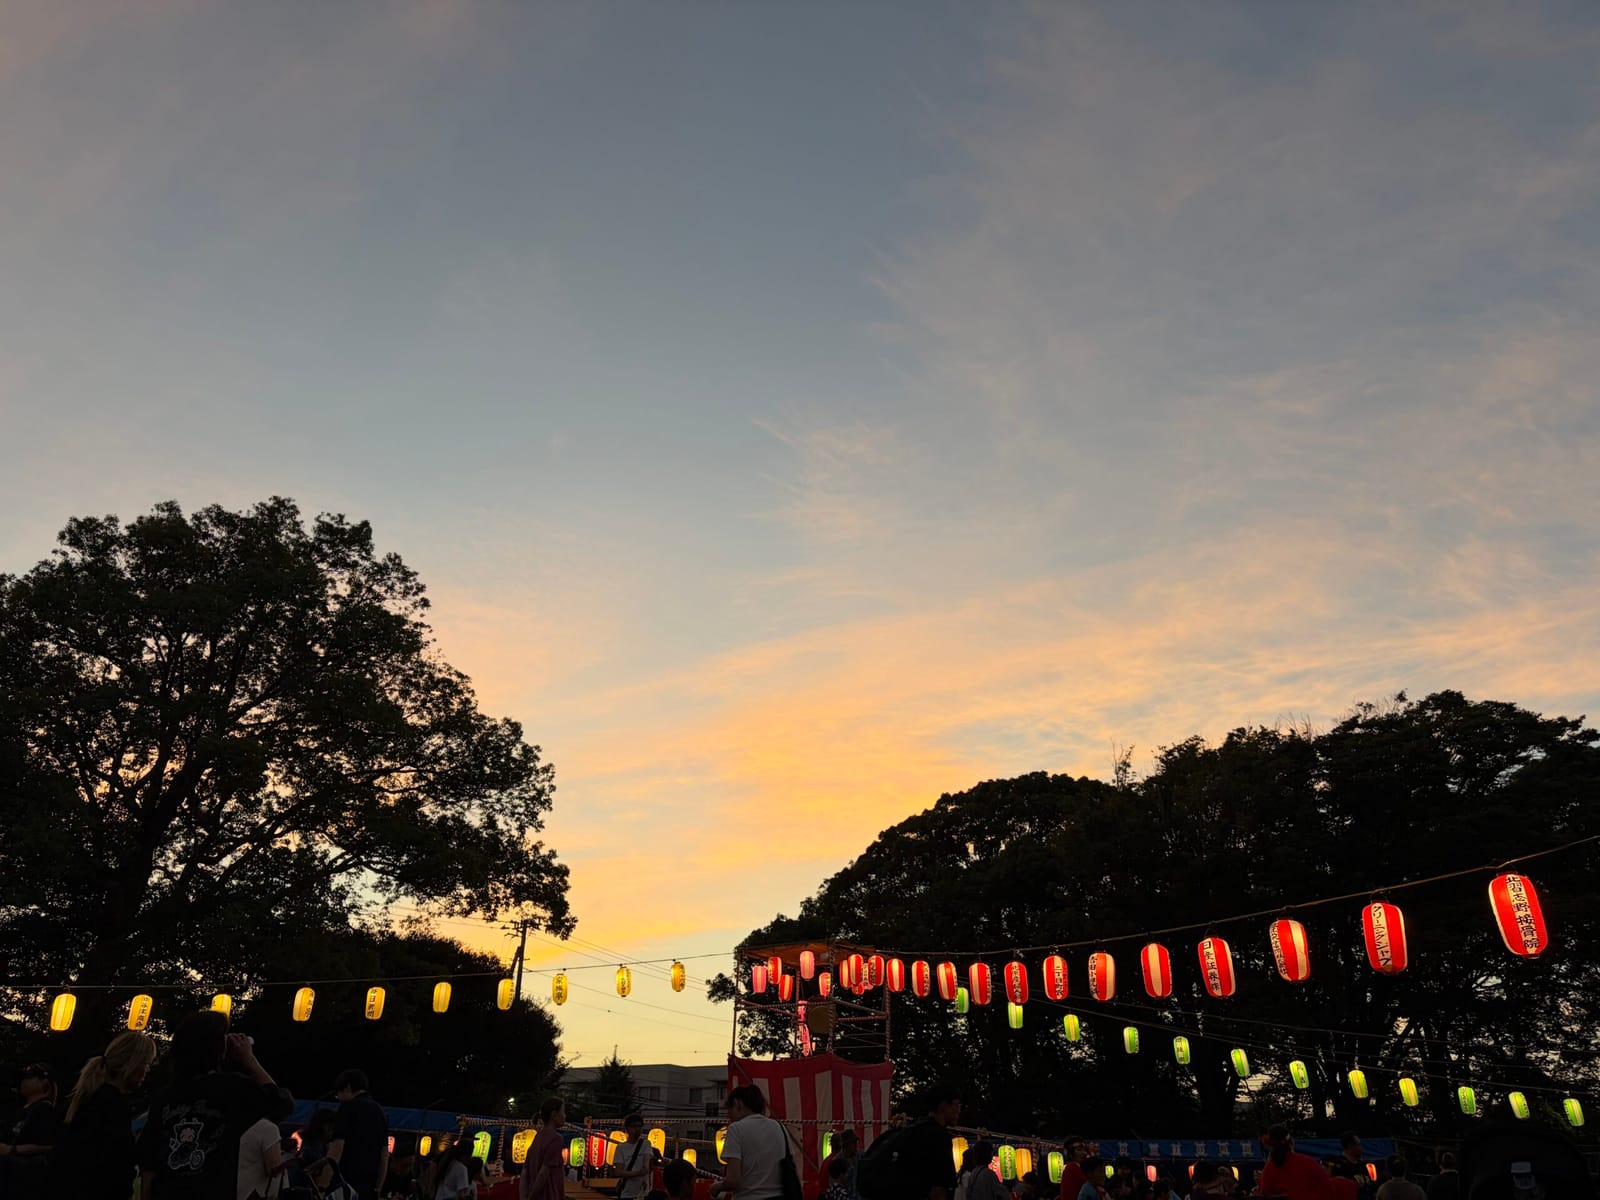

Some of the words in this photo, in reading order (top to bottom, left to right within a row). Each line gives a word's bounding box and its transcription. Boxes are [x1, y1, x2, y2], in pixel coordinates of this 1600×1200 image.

[1505, 876, 1540, 949] 北習志野接骨院
